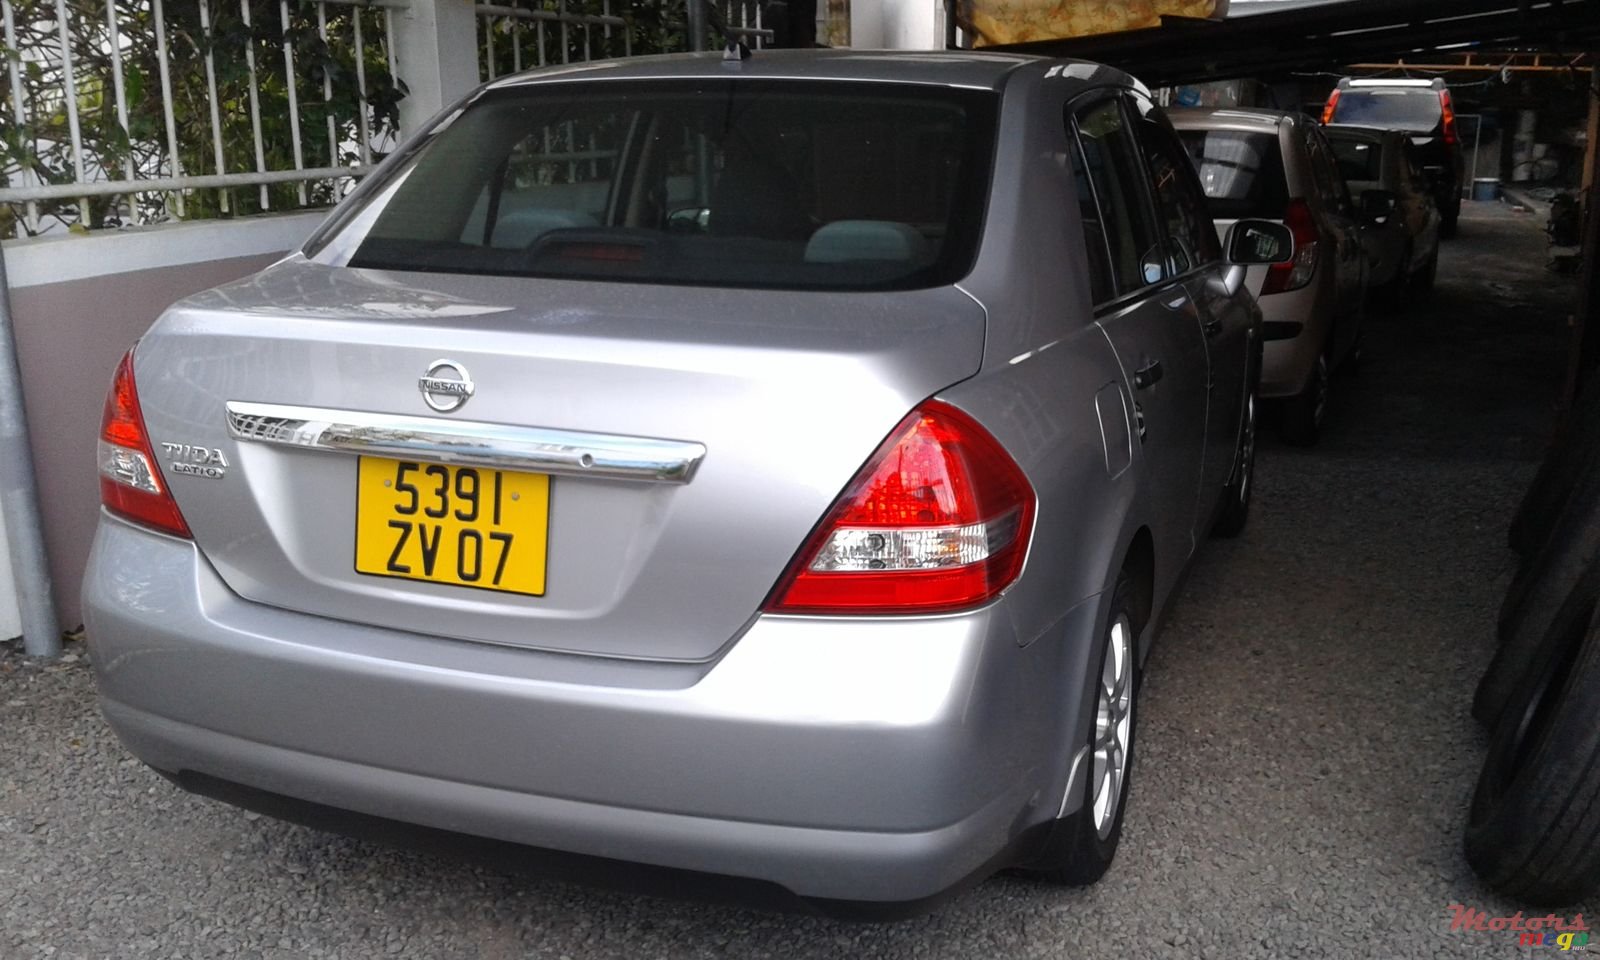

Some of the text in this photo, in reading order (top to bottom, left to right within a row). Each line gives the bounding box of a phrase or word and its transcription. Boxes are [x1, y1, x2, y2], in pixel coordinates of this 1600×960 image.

[421, 379, 466, 393] NISSAN
[161, 442, 229, 467] TIIDA
[173, 464, 218, 477] LATIO
[394, 462, 502, 525] 5391
[387, 520, 514, 585] ZV 07
